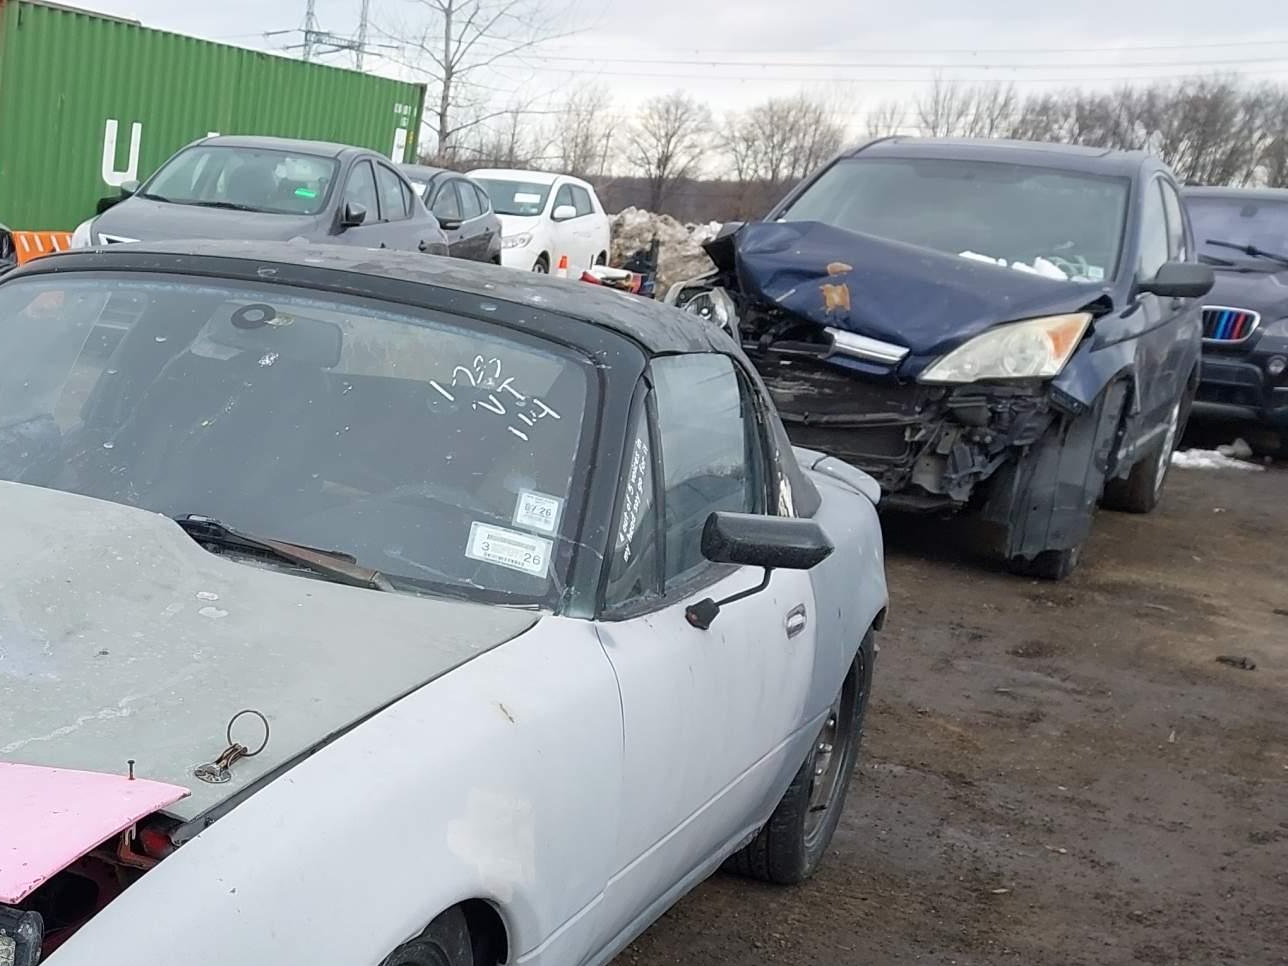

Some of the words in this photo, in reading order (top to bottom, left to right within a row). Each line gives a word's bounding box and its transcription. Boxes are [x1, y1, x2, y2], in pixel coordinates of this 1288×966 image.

[625, 493, 632, 512] of
[631, 450, 640, 483] voices
[539, 507, 552, 517] 26
[626, 511, 636, 543] head
[480, 541, 491, 552] 3
[523, 552, 541, 566] 26
